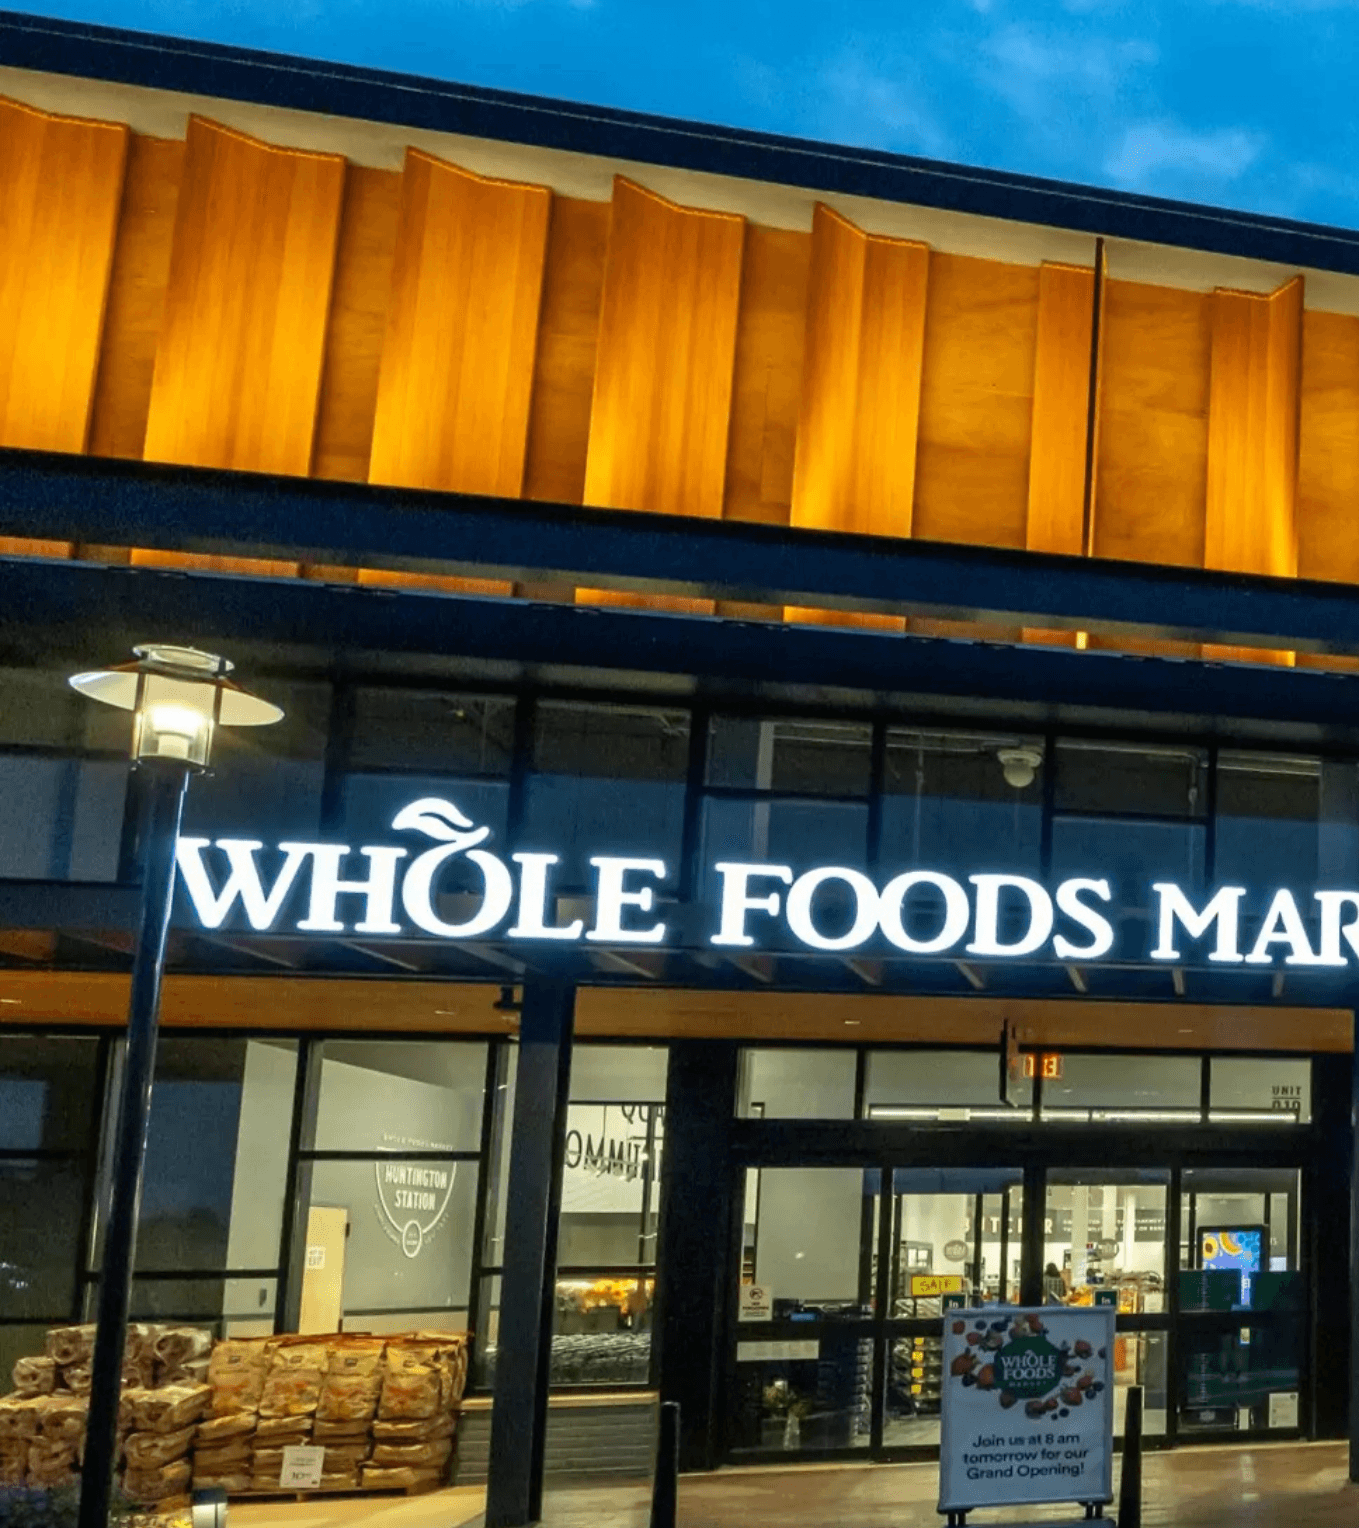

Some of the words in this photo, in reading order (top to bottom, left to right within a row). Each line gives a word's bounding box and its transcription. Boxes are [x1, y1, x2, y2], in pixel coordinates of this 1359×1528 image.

[175, 797, 667, 944] WHOLE
[710, 861, 1115, 960] FOODS
[1271, 1085, 1302, 1096] UNIT
[385, 1164, 448, 1189] HUNTINGTON
[394, 1189, 436, 1210] STATION
[1001, 1350, 1057, 1370] WHOLE
[1003, 1367, 1056, 1381] FOODS
[972, 1434, 1005, 1448] Join
[1009, 1436, 1025, 1446] us
[1028, 1434, 1041, 1446] at
[1045, 1434, 1054, 1445] 8
[1057, 1434, 1080, 1445] am
[963, 1450, 1038, 1465] tomorrow
[1041, 1448, 1061, 1460] for
[1064, 1449, 1089, 1459] our
[966, 1465, 1013, 1480] Grand
[1017, 1461, 1085, 1478] Opening!
